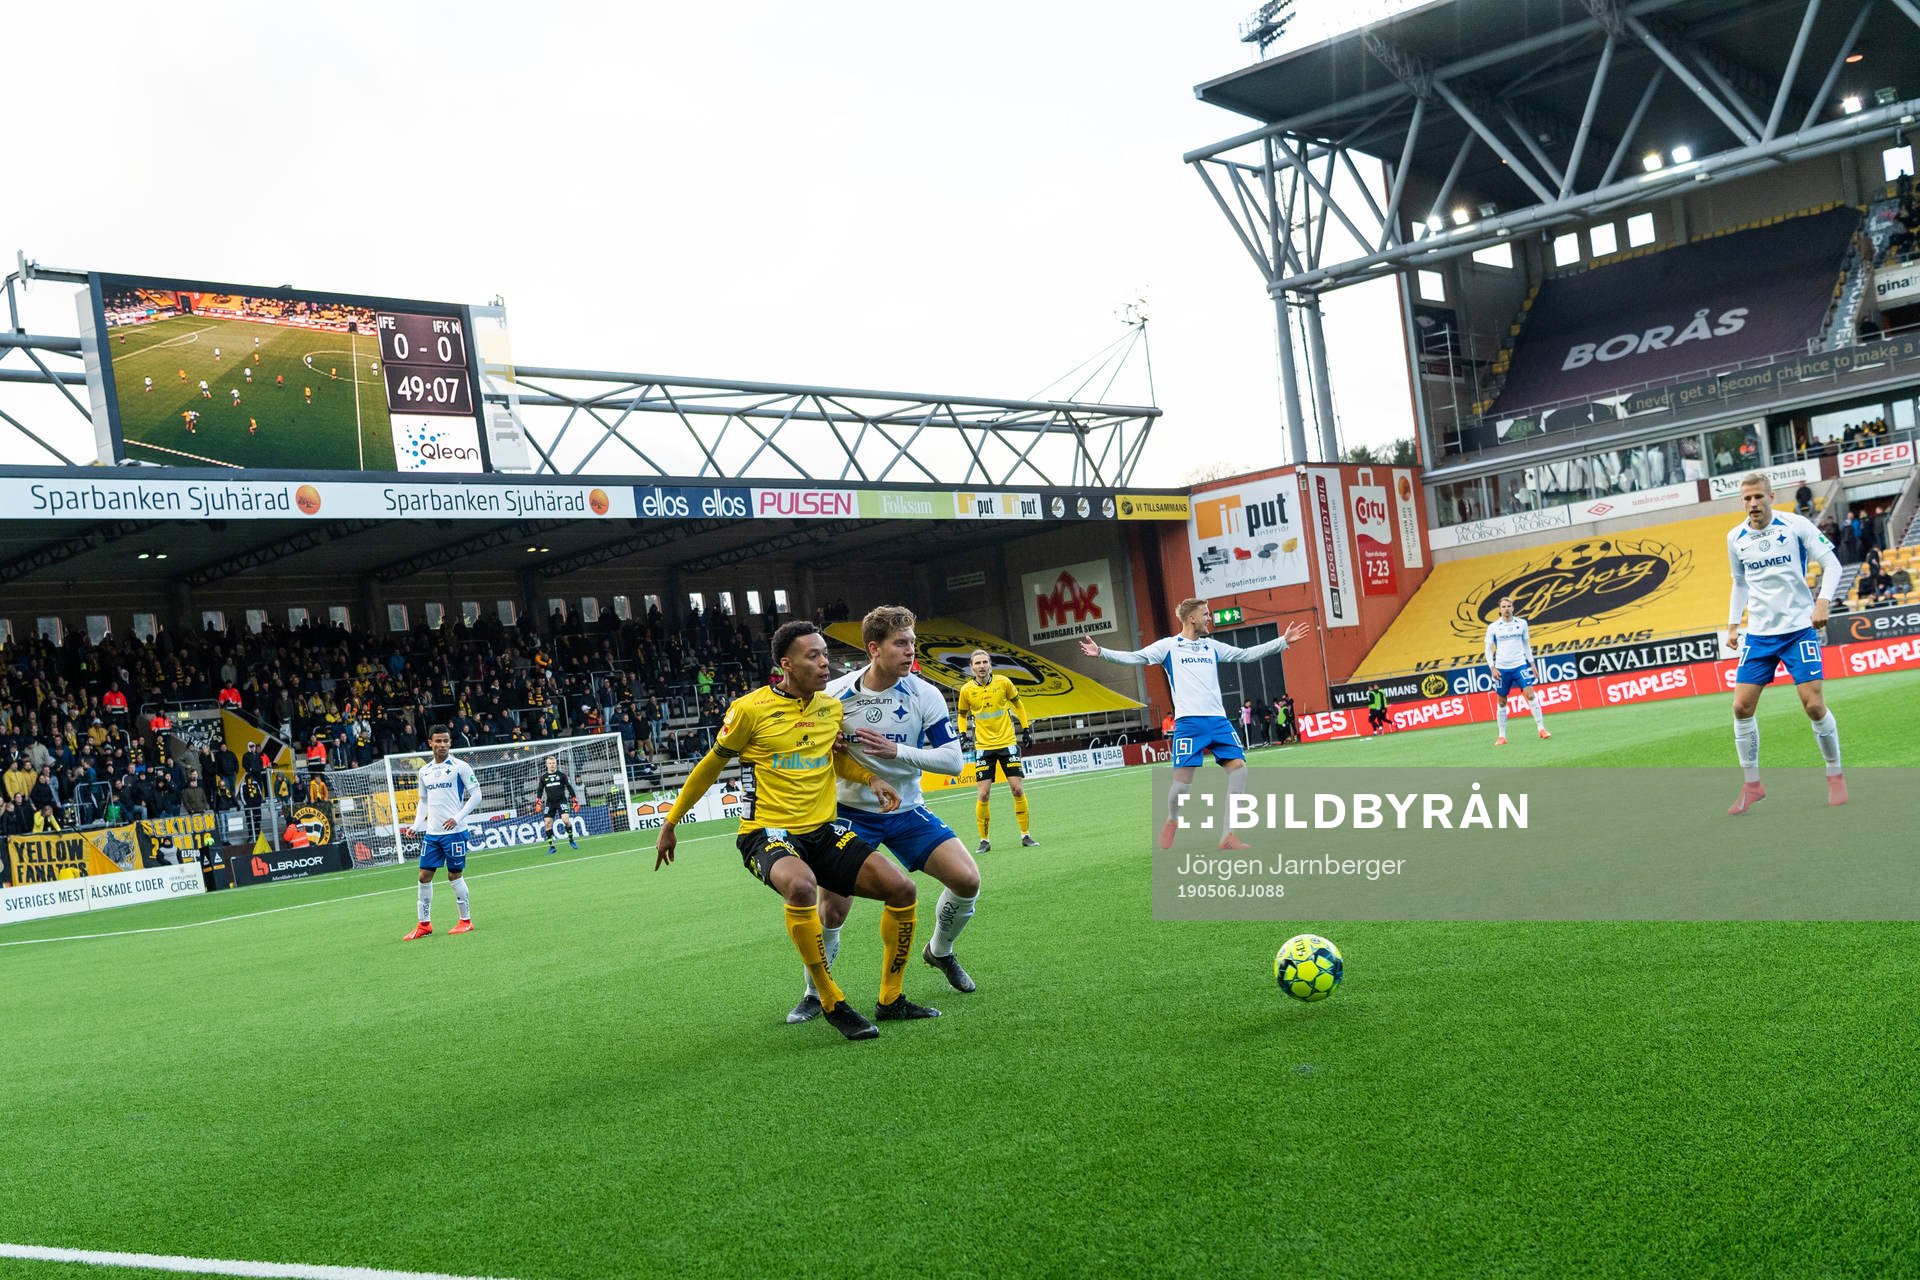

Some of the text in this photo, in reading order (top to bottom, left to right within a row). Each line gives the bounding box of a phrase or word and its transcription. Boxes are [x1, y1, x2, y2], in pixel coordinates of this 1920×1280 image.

[379, 316, 396, 330] IFE
[433, 320, 460, 335] IFK N
[393, 333, 409, 360] 0
[437, 336, 452, 362] 0
[1561, 306, 1749, 371] BORÅS
[1635, 390, 1675, 410] never
[1679, 387, 1704, 402] get
[1707, 384, 1717, 395] a
[1720, 370, 1772, 391] second
[1776, 359, 1829, 382] chance
[1833, 353, 1850, 369] to
[1855, 345, 1899, 365] make
[1904, 341, 1914, 354] a
[397, 375, 460, 403] 49:07
[420, 443, 479, 461] Qlean
[1843, 444, 1910, 469] SPEED
[31, 485, 290, 516] Sparbanken Sjuhärad
[383, 488, 585, 516] Sparbanken Sjuhärad
[643, 488, 689, 517] ellos
[702, 489, 746, 517] ellos
[1318, 480, 1328, 503] BIL
[759, 492, 852, 515] PULSEN
[882, 494, 933, 515] Folksam
[1136, 502, 1187, 513] VI TILLSAMMANS
[1355, 495, 1386, 526] City
[1455, 522, 1485, 534] OSCAR
[1512, 511, 1543, 523] OSCAR
[1514, 515, 1565, 535] JACOBSON
[1319, 504, 1338, 583] BOGSTEDT
[1457, 526, 1506, 544] JACOBSON
[1365, 560, 1390, 578] 7-23
[1225, 574, 1277, 589] inputinterior.se
[1484, 556, 1658, 622] Elfsborg
[1035, 570, 1103, 629] MAX
[1033, 621, 1113, 642] HAMBURGARE PÅ SVENSKA
[1414, 659, 1444, 673] VI
[1578, 639, 1714, 676] CAVALIERE
[1607, 668, 1688, 703] STAPLES
[857, 697, 893, 707] stadium
[1335, 694, 1345, 704] VI
[1394, 697, 1465, 729] STAPLES
[944, 721, 957, 739] C
[1032, 757, 1054, 769] UBAB
[1067, 753, 1088, 766] UBAB
[1103, 749, 1123, 761] UBAB
[141, 813, 217, 836] SEKTION
[467, 816, 590, 851] Caveron
[14, 838, 84, 863] YELLOW
[270, 856, 323, 872] L.BRADOR
[91, 877, 165, 899] ÄLSKADE CIDER
[170, 880, 199, 893] CIDER
[5, 888, 85, 912] SVERIGES MEST
[890, 921, 913, 974] FRISTADS
